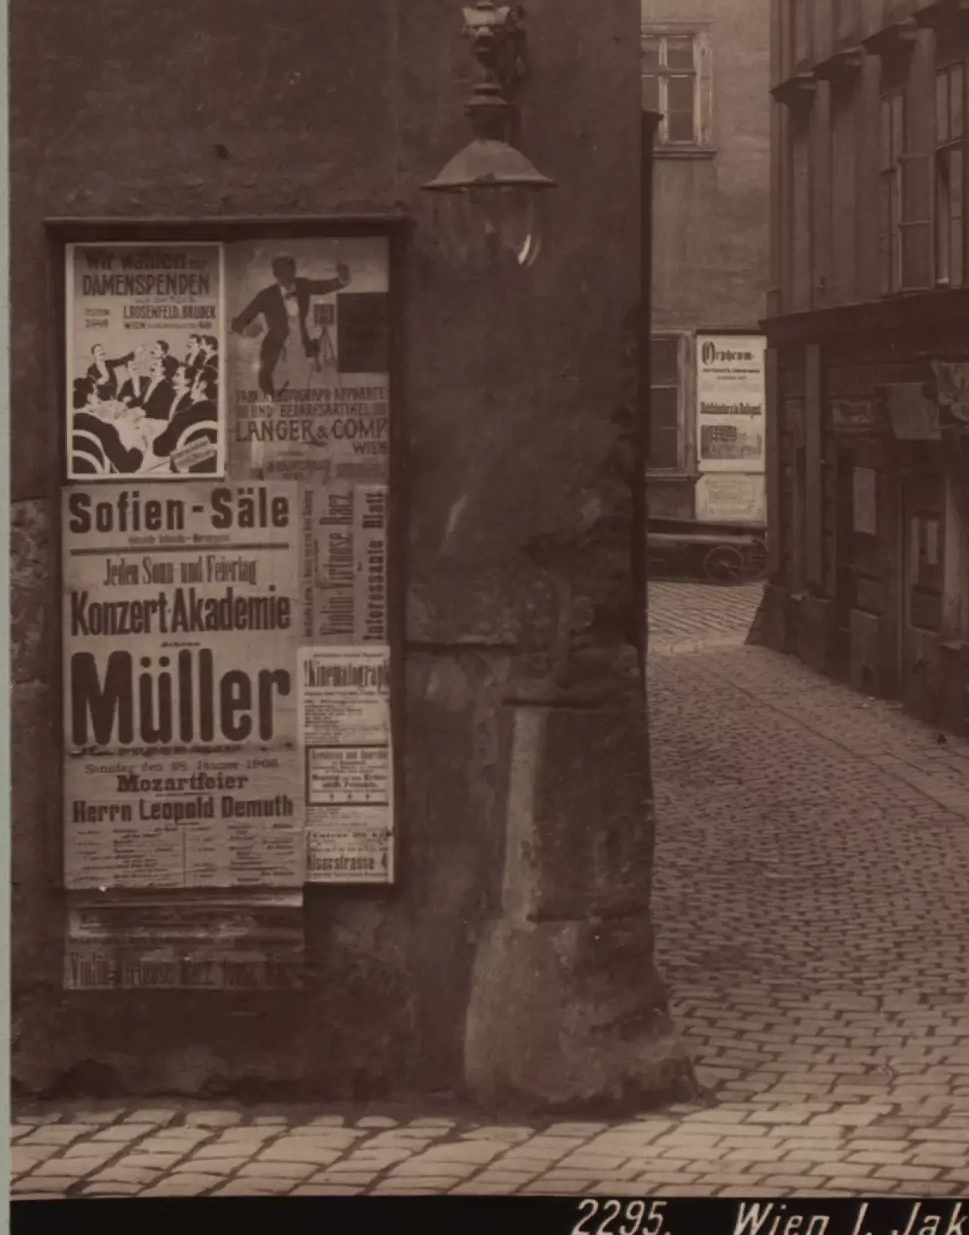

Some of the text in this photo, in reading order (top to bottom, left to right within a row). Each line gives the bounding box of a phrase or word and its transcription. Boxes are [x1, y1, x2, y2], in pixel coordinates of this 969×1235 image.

[83, 274, 210, 296] DAMENSPENDEN
[236, 419, 316, 446] LANGER
[316, 425, 330, 440] &
[361, 491, 384, 529] Blatt
[104, 557, 139, 586] Jeden
[179, 555, 203, 584] und
[206, 554, 258, 586] Feiertag
[70, 648, 292, 746] Müller
[116, 771, 249, 793] Mozartfeier
[72, 800, 133, 823] Herrn
[138, 796, 216, 825] Leopold
[221, 794, 295, 819] Demuth
